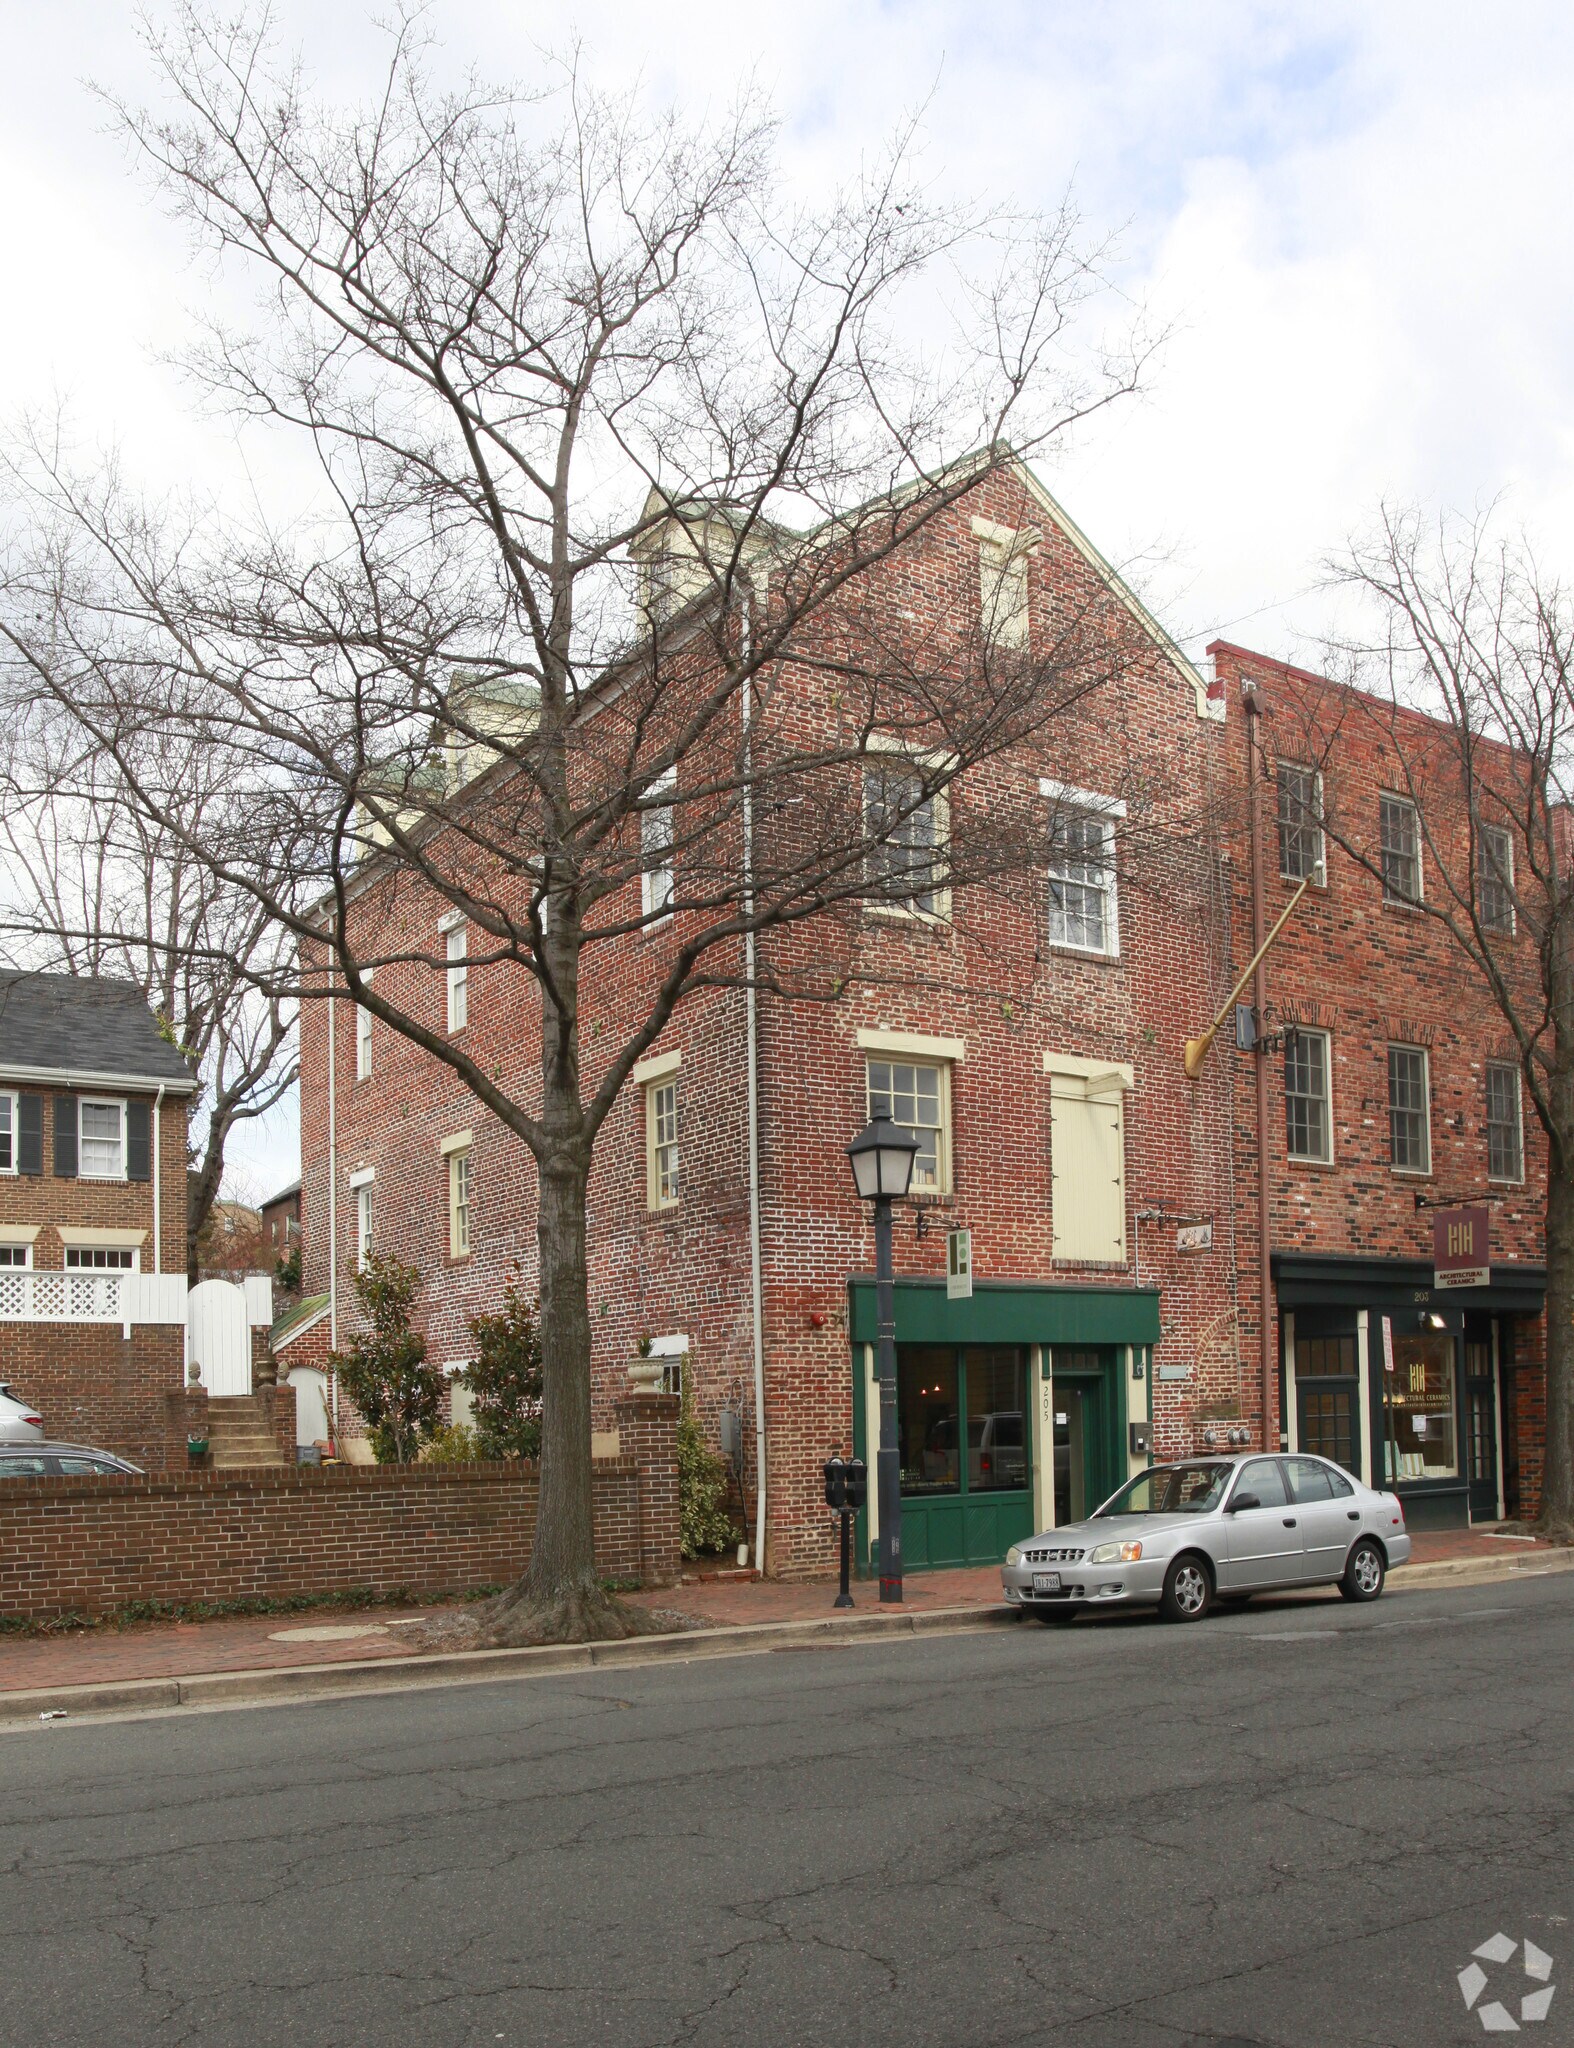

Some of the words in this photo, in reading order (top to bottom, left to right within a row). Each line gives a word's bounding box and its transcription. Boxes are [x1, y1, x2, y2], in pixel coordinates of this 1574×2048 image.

[1439, 1271, 1483, 1280] ARCHITECTURAL
[1447, 1278, 1475, 1286] CERAMICS
[1414, 1291, 1430, 1302] 203
